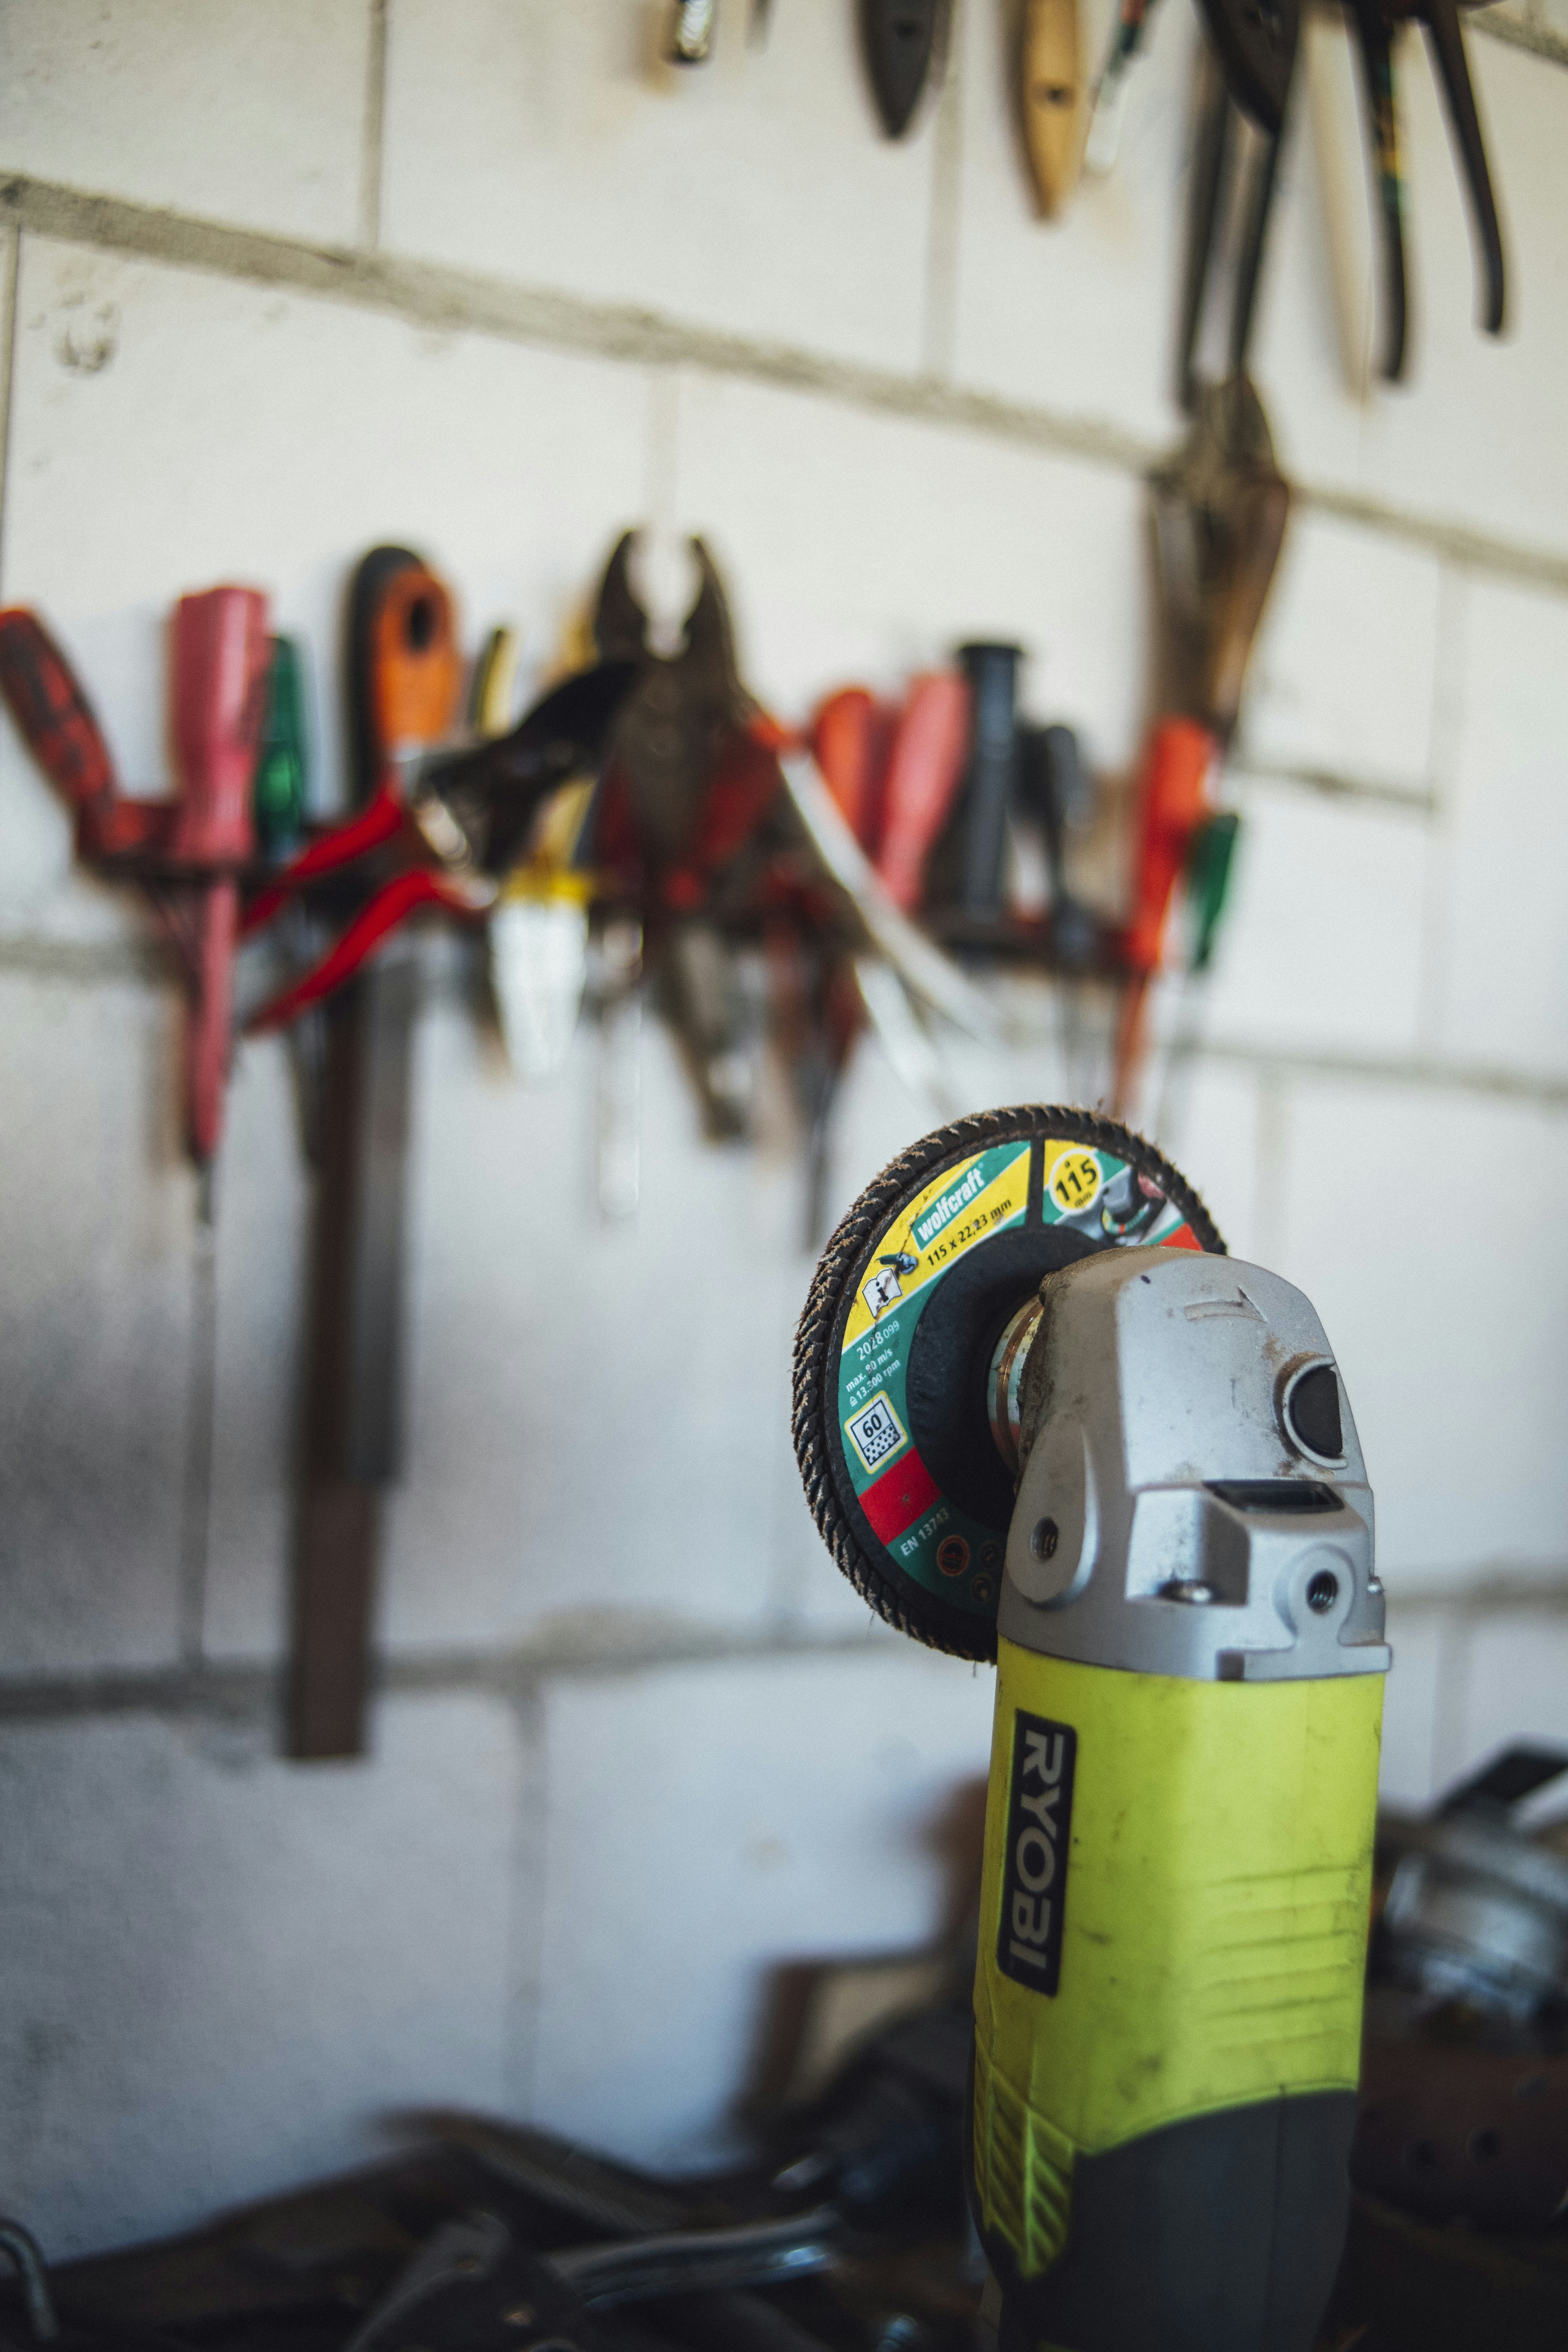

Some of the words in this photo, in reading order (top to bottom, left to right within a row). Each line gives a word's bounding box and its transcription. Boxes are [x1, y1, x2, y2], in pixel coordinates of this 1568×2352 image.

[1056, 1158, 1096, 1202] 115
[918, 1167, 984, 1241] wolfcraft
[927, 1244, 947, 1265] 115
[949, 1239, 957, 1250] x
[958, 1214, 988, 1243] 22,23
[990, 1200, 1011, 1219] mm
[846, 1372, 866, 1392] max.
[866, 1360, 877, 1374] 80
[878, 1348, 893, 1365] m/s
[883, 1360, 901, 1376] rpm
[862, 1414, 882, 1438] 60
[901, 1536, 918, 1556] EN
[1009, 1729, 1064, 1969] RYOBI
